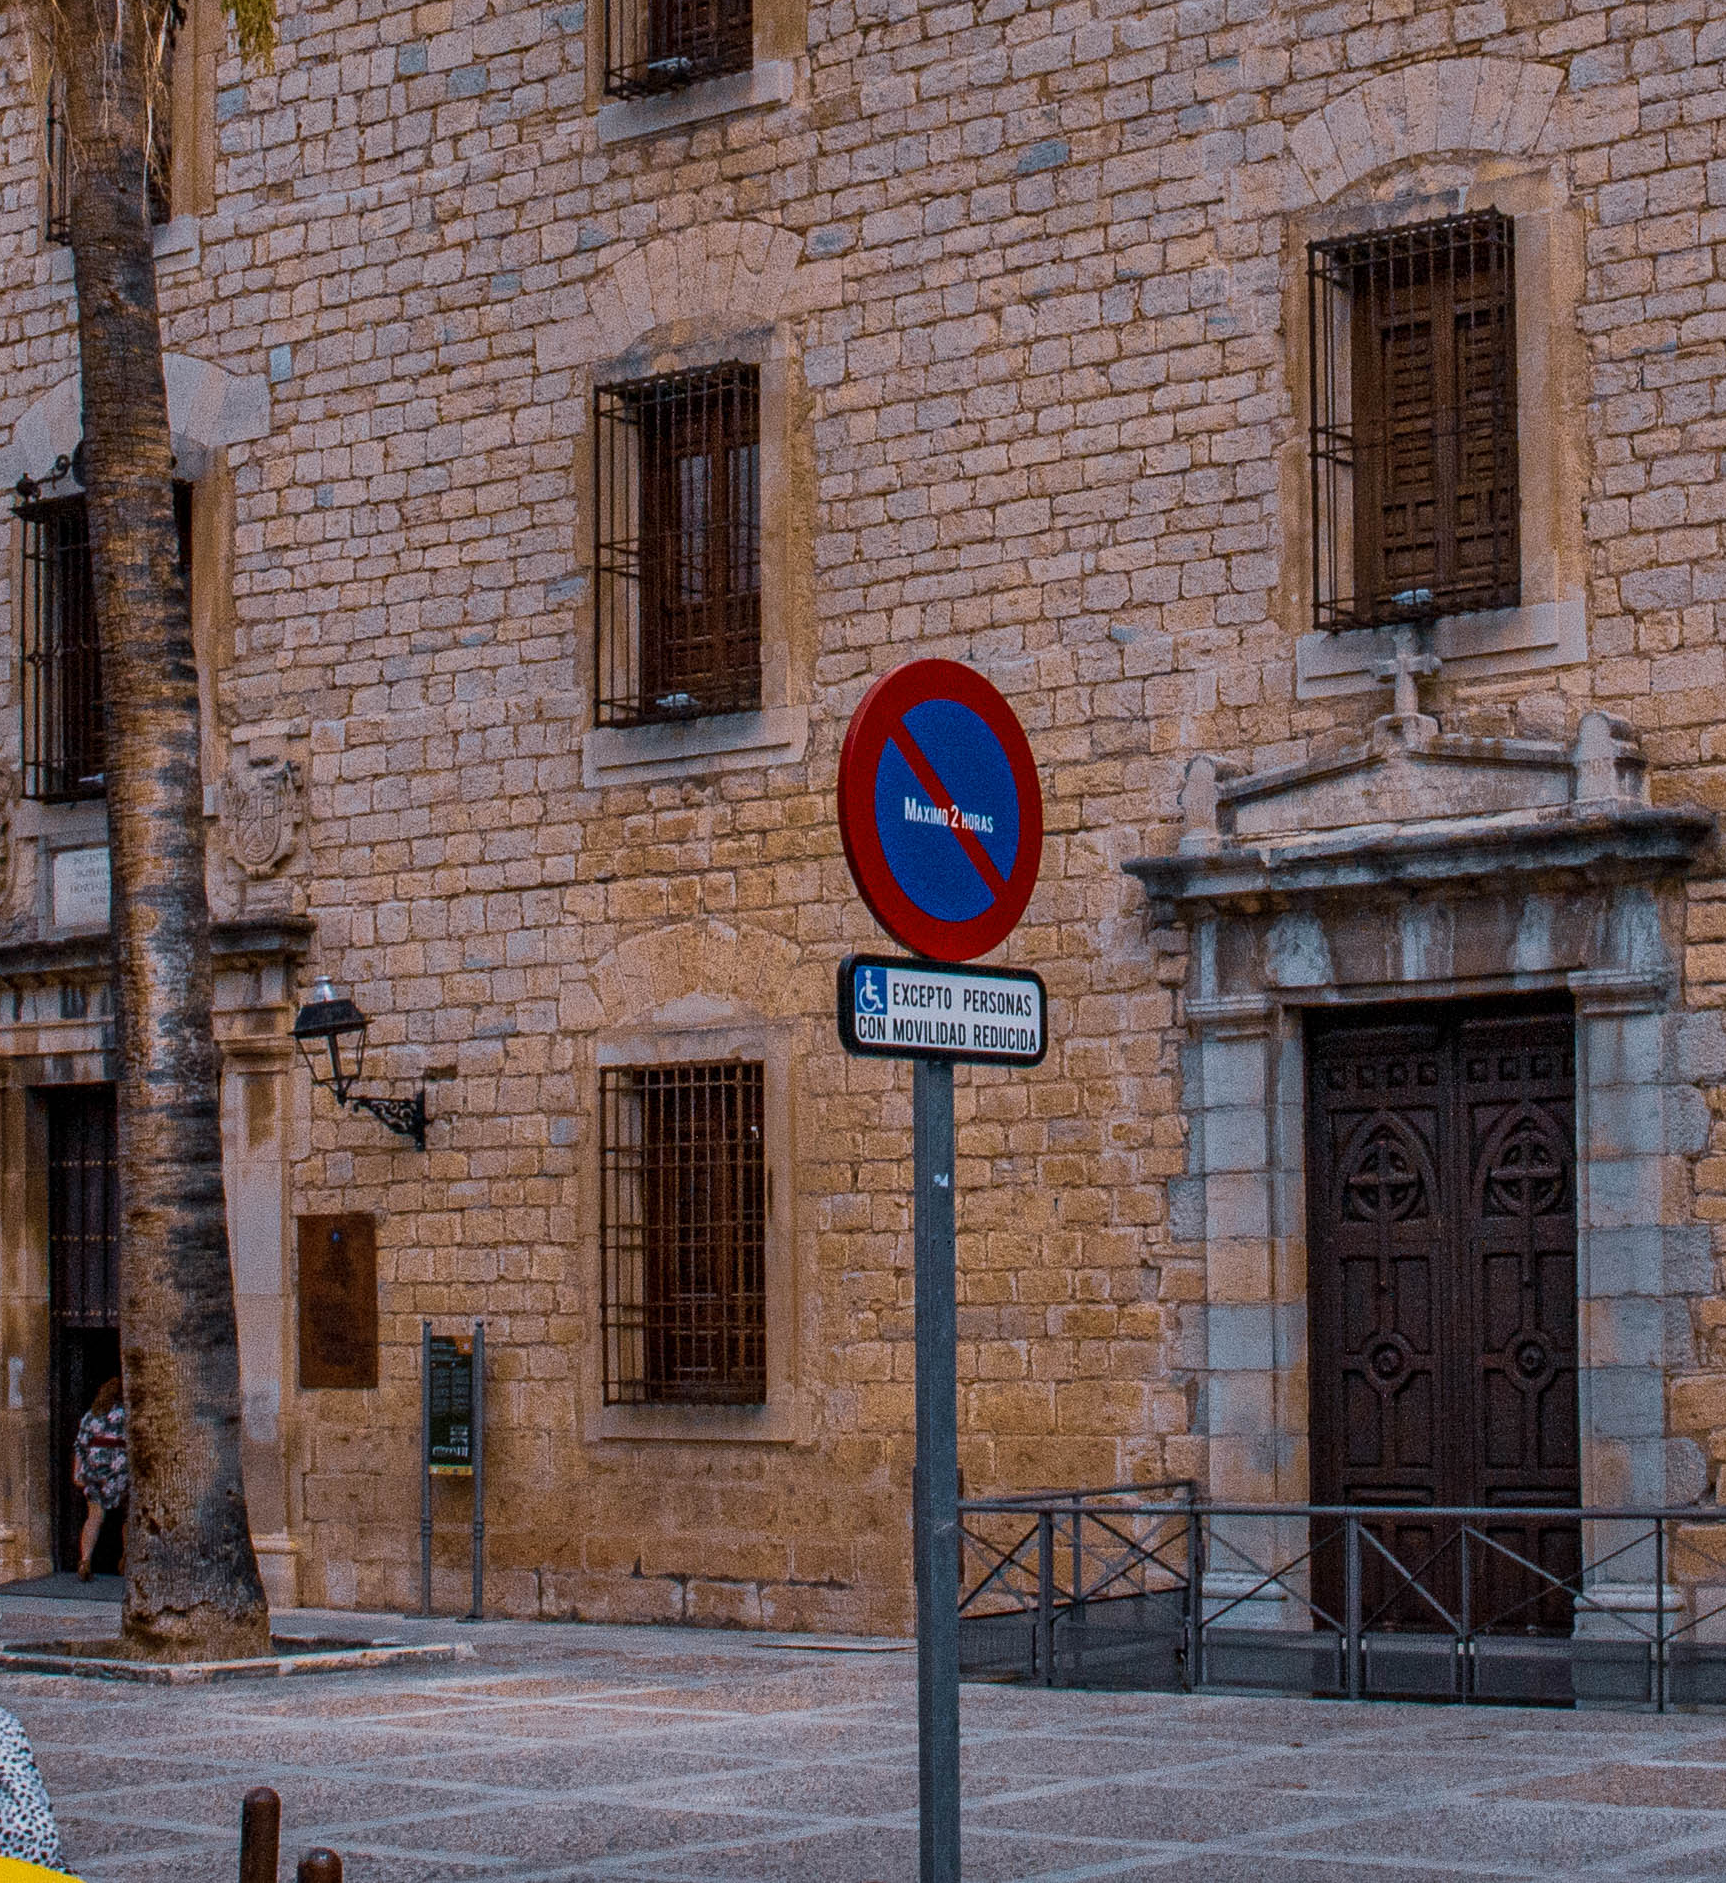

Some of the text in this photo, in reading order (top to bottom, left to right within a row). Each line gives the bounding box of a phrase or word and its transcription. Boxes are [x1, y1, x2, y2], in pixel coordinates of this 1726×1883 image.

[904, 796, 994, 834] MAXIMO 2 HORAS
[892, 982, 1032, 1017] EXCEPTO PERSONAS
[858, 1015, 1037, 1052] CON MOVILIDAD REDUCIDA
